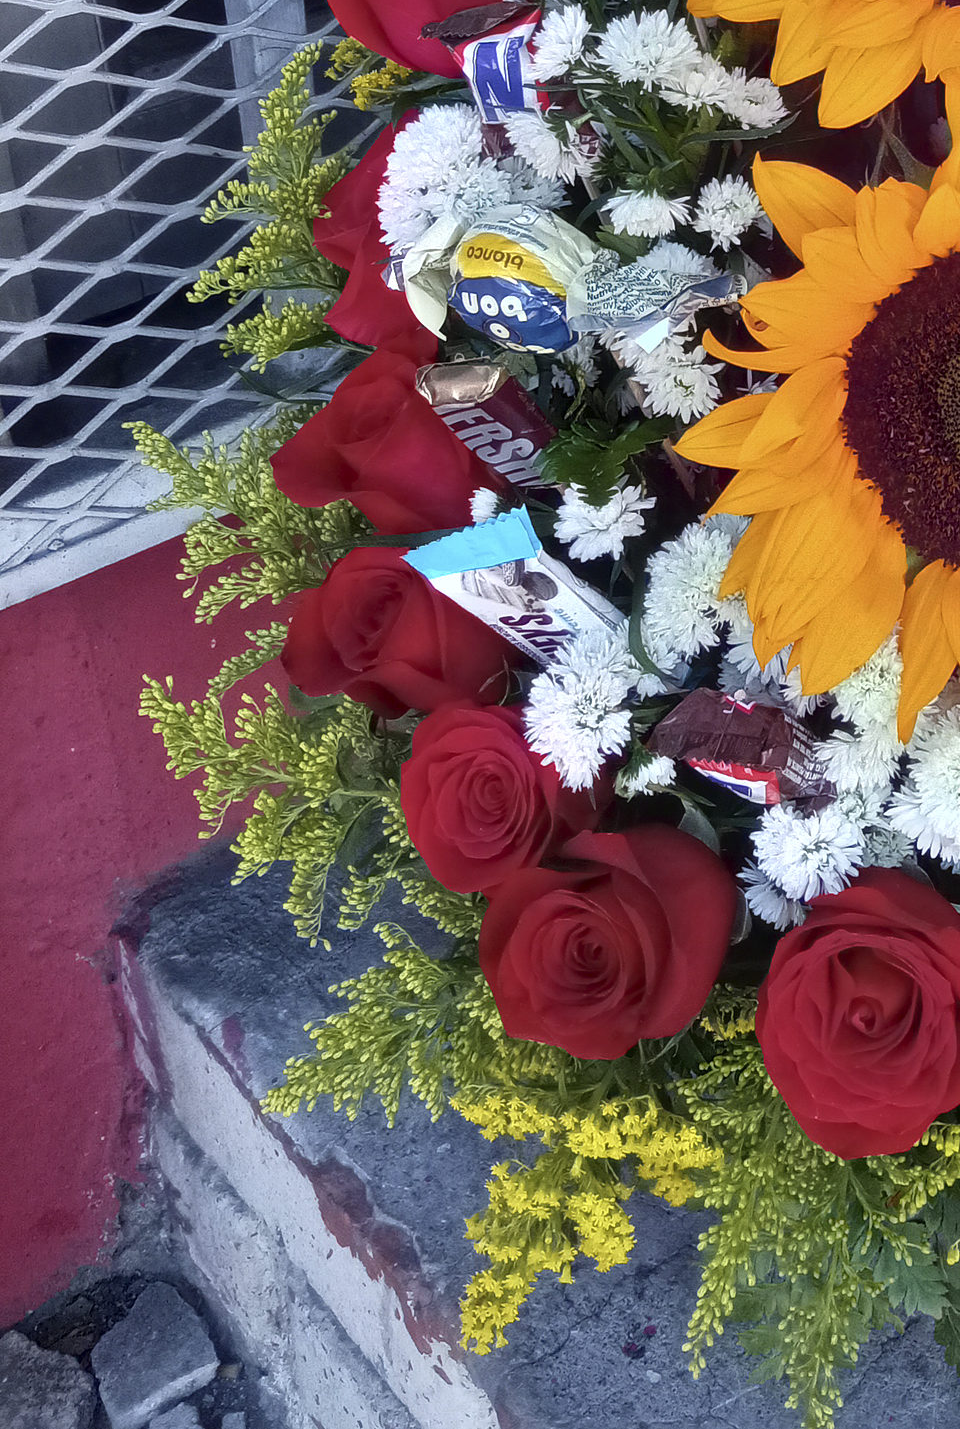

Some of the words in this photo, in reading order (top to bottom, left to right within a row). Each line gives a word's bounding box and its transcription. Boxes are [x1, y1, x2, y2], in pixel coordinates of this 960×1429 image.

[466, 244, 526, 271] blanco
[460, 291, 528, 323] bon
[434, 405, 561, 487] ERSH
[499, 613, 577, 666] EY'S
